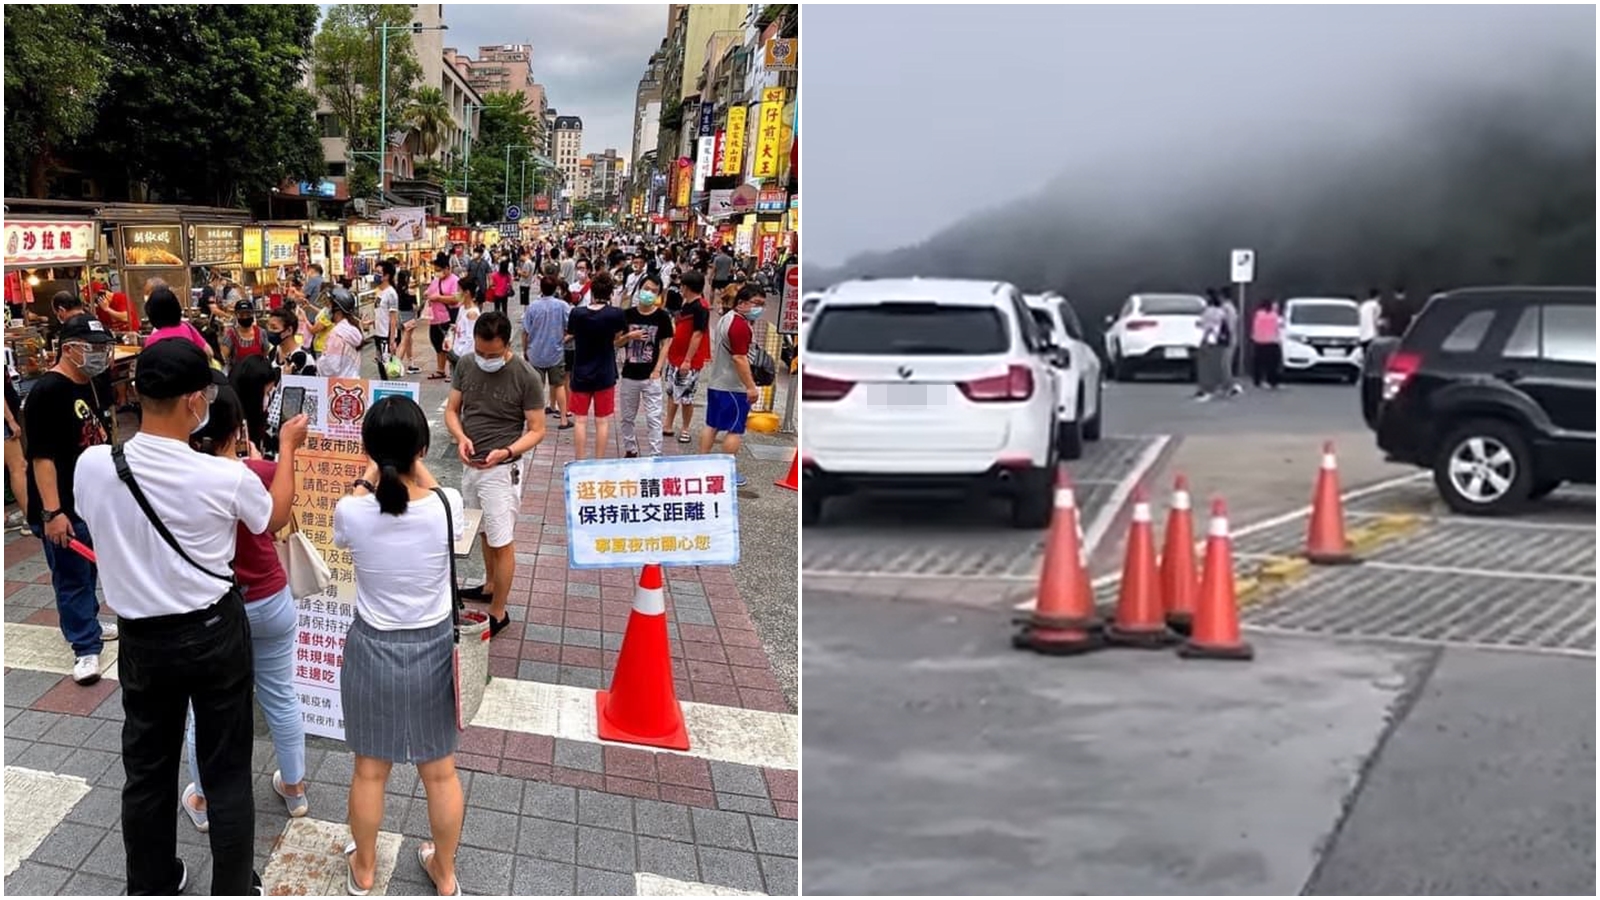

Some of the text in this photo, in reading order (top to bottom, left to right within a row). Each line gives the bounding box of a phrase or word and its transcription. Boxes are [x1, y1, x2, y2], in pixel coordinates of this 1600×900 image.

[760, 90, 782, 174] 蚵仔煎大王
[299, 436, 367, 454] 夏夜市防
[577, 475, 725, 499] 逛夜市請戴口罩
[578, 501, 719, 525] 保持社交距離！
[595, 535, 711, 553] 寧夏夜市關心您
[296, 665, 335, 683] 走邊吃
